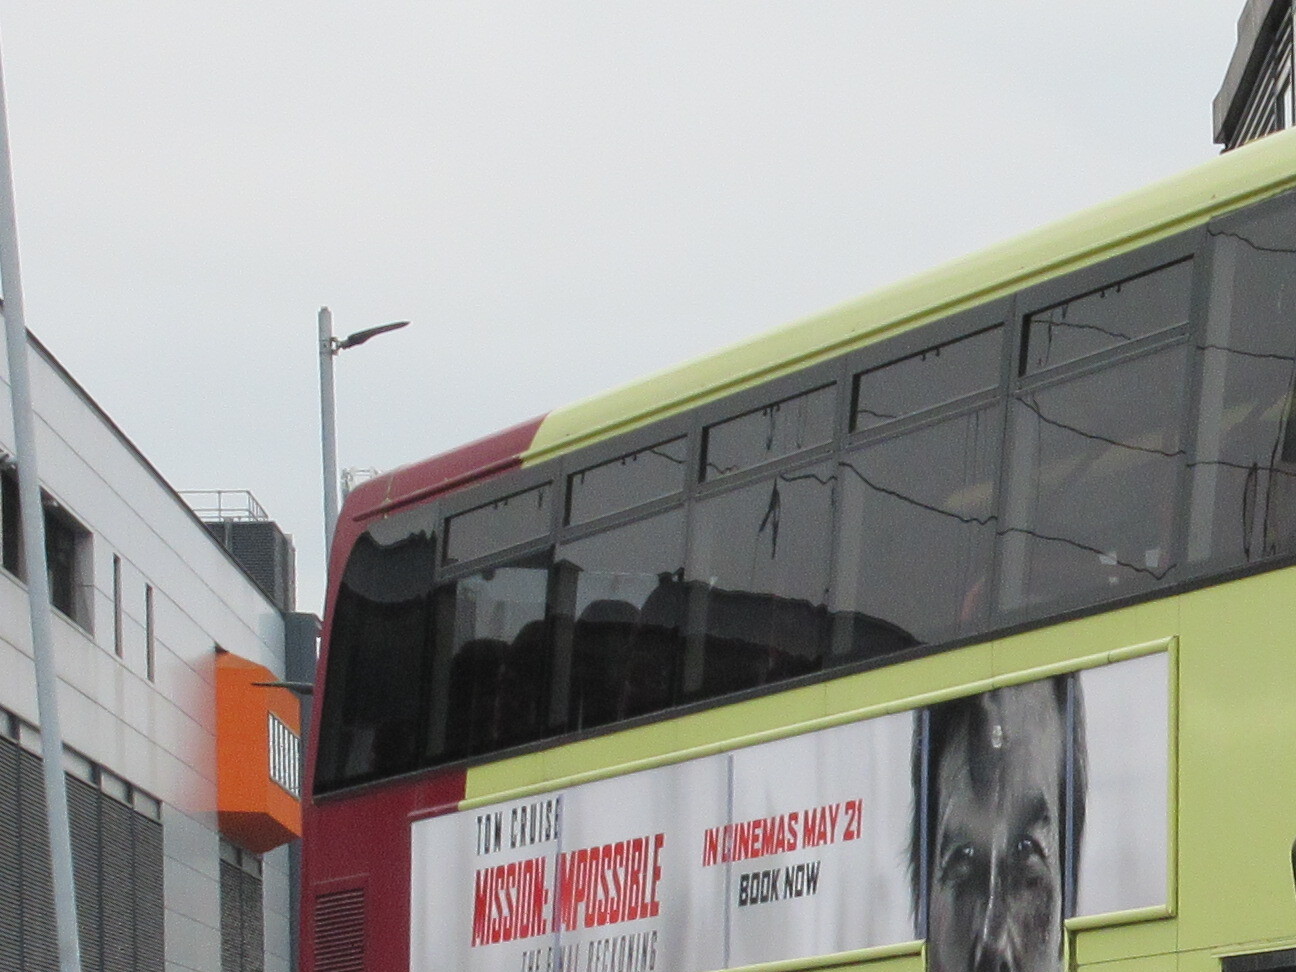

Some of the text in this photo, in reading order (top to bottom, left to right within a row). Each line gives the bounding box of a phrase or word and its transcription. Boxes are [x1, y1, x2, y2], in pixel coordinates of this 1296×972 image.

[510, 798, 561, 849] CRUISE
[703, 799, 864, 867] IN CINEMAS MAY 21
[552, 833, 664, 933] IMPOSSIBLE
[738, 861, 821, 907] BOOK NOW
